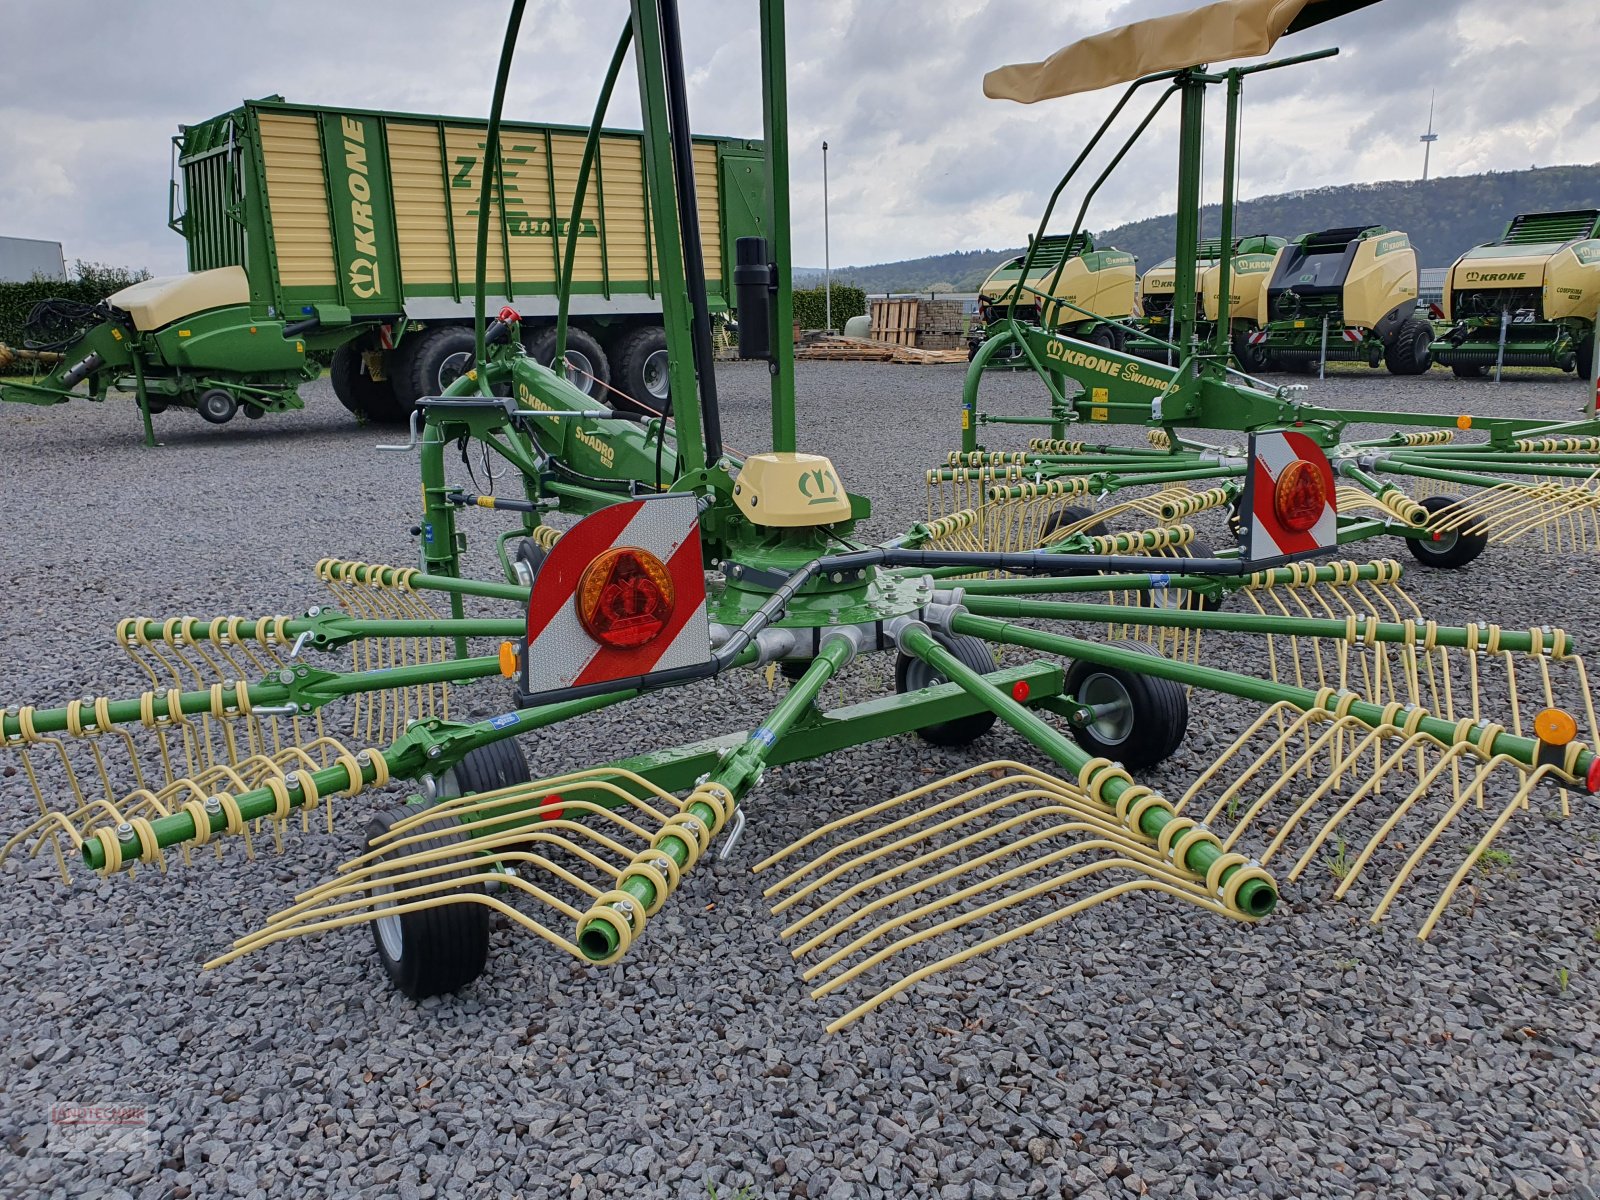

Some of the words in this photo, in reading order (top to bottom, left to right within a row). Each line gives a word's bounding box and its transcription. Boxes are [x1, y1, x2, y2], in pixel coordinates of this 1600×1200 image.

[341, 115, 377, 257] KRONE
[519, 221, 550, 235] 450
[1480, 272, 1526, 282] KRONE
[1062, 348, 1122, 378] KRONE
[575, 426, 615, 461] SWADRO
